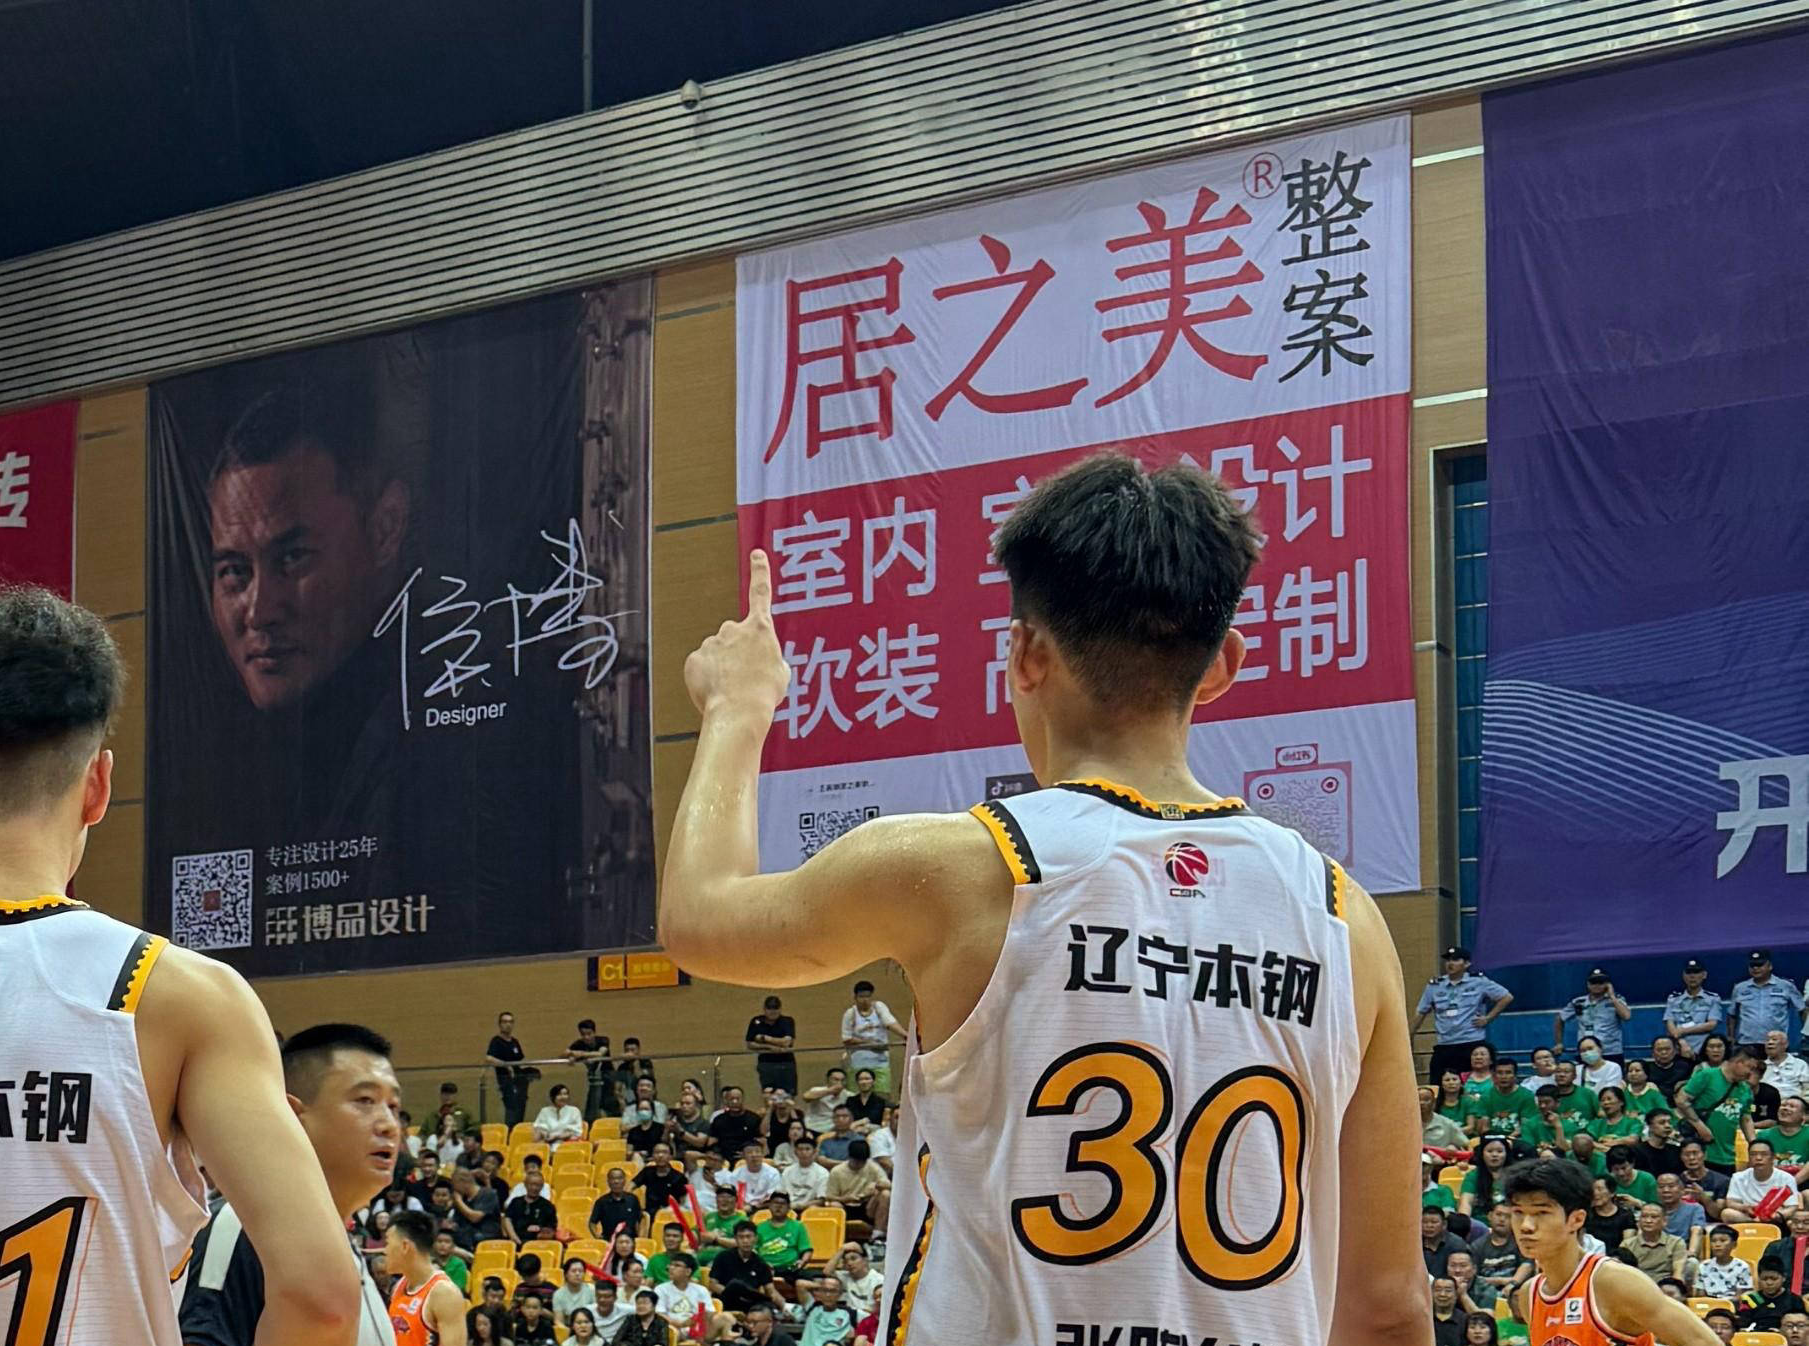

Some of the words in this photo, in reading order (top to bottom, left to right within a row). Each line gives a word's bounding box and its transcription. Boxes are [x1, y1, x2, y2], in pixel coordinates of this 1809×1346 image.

[1277, 150, 1374, 383] 整案
[763, 186, 1269, 465] 居之美
[771, 496, 937, 615] 室内
[425, 702, 507, 728] Designer
[773, 623, 940, 740] 软装
[265, 836, 378, 867] 专注设计25年
[1716, 755, 1809, 881] 开
[265, 870, 350, 896] 案例1500+
[302, 894, 437, 943] 博品设计
[1063, 923, 1321, 1028] 辽宁本钢
[1010, 1040, 1313, 1292] 30
